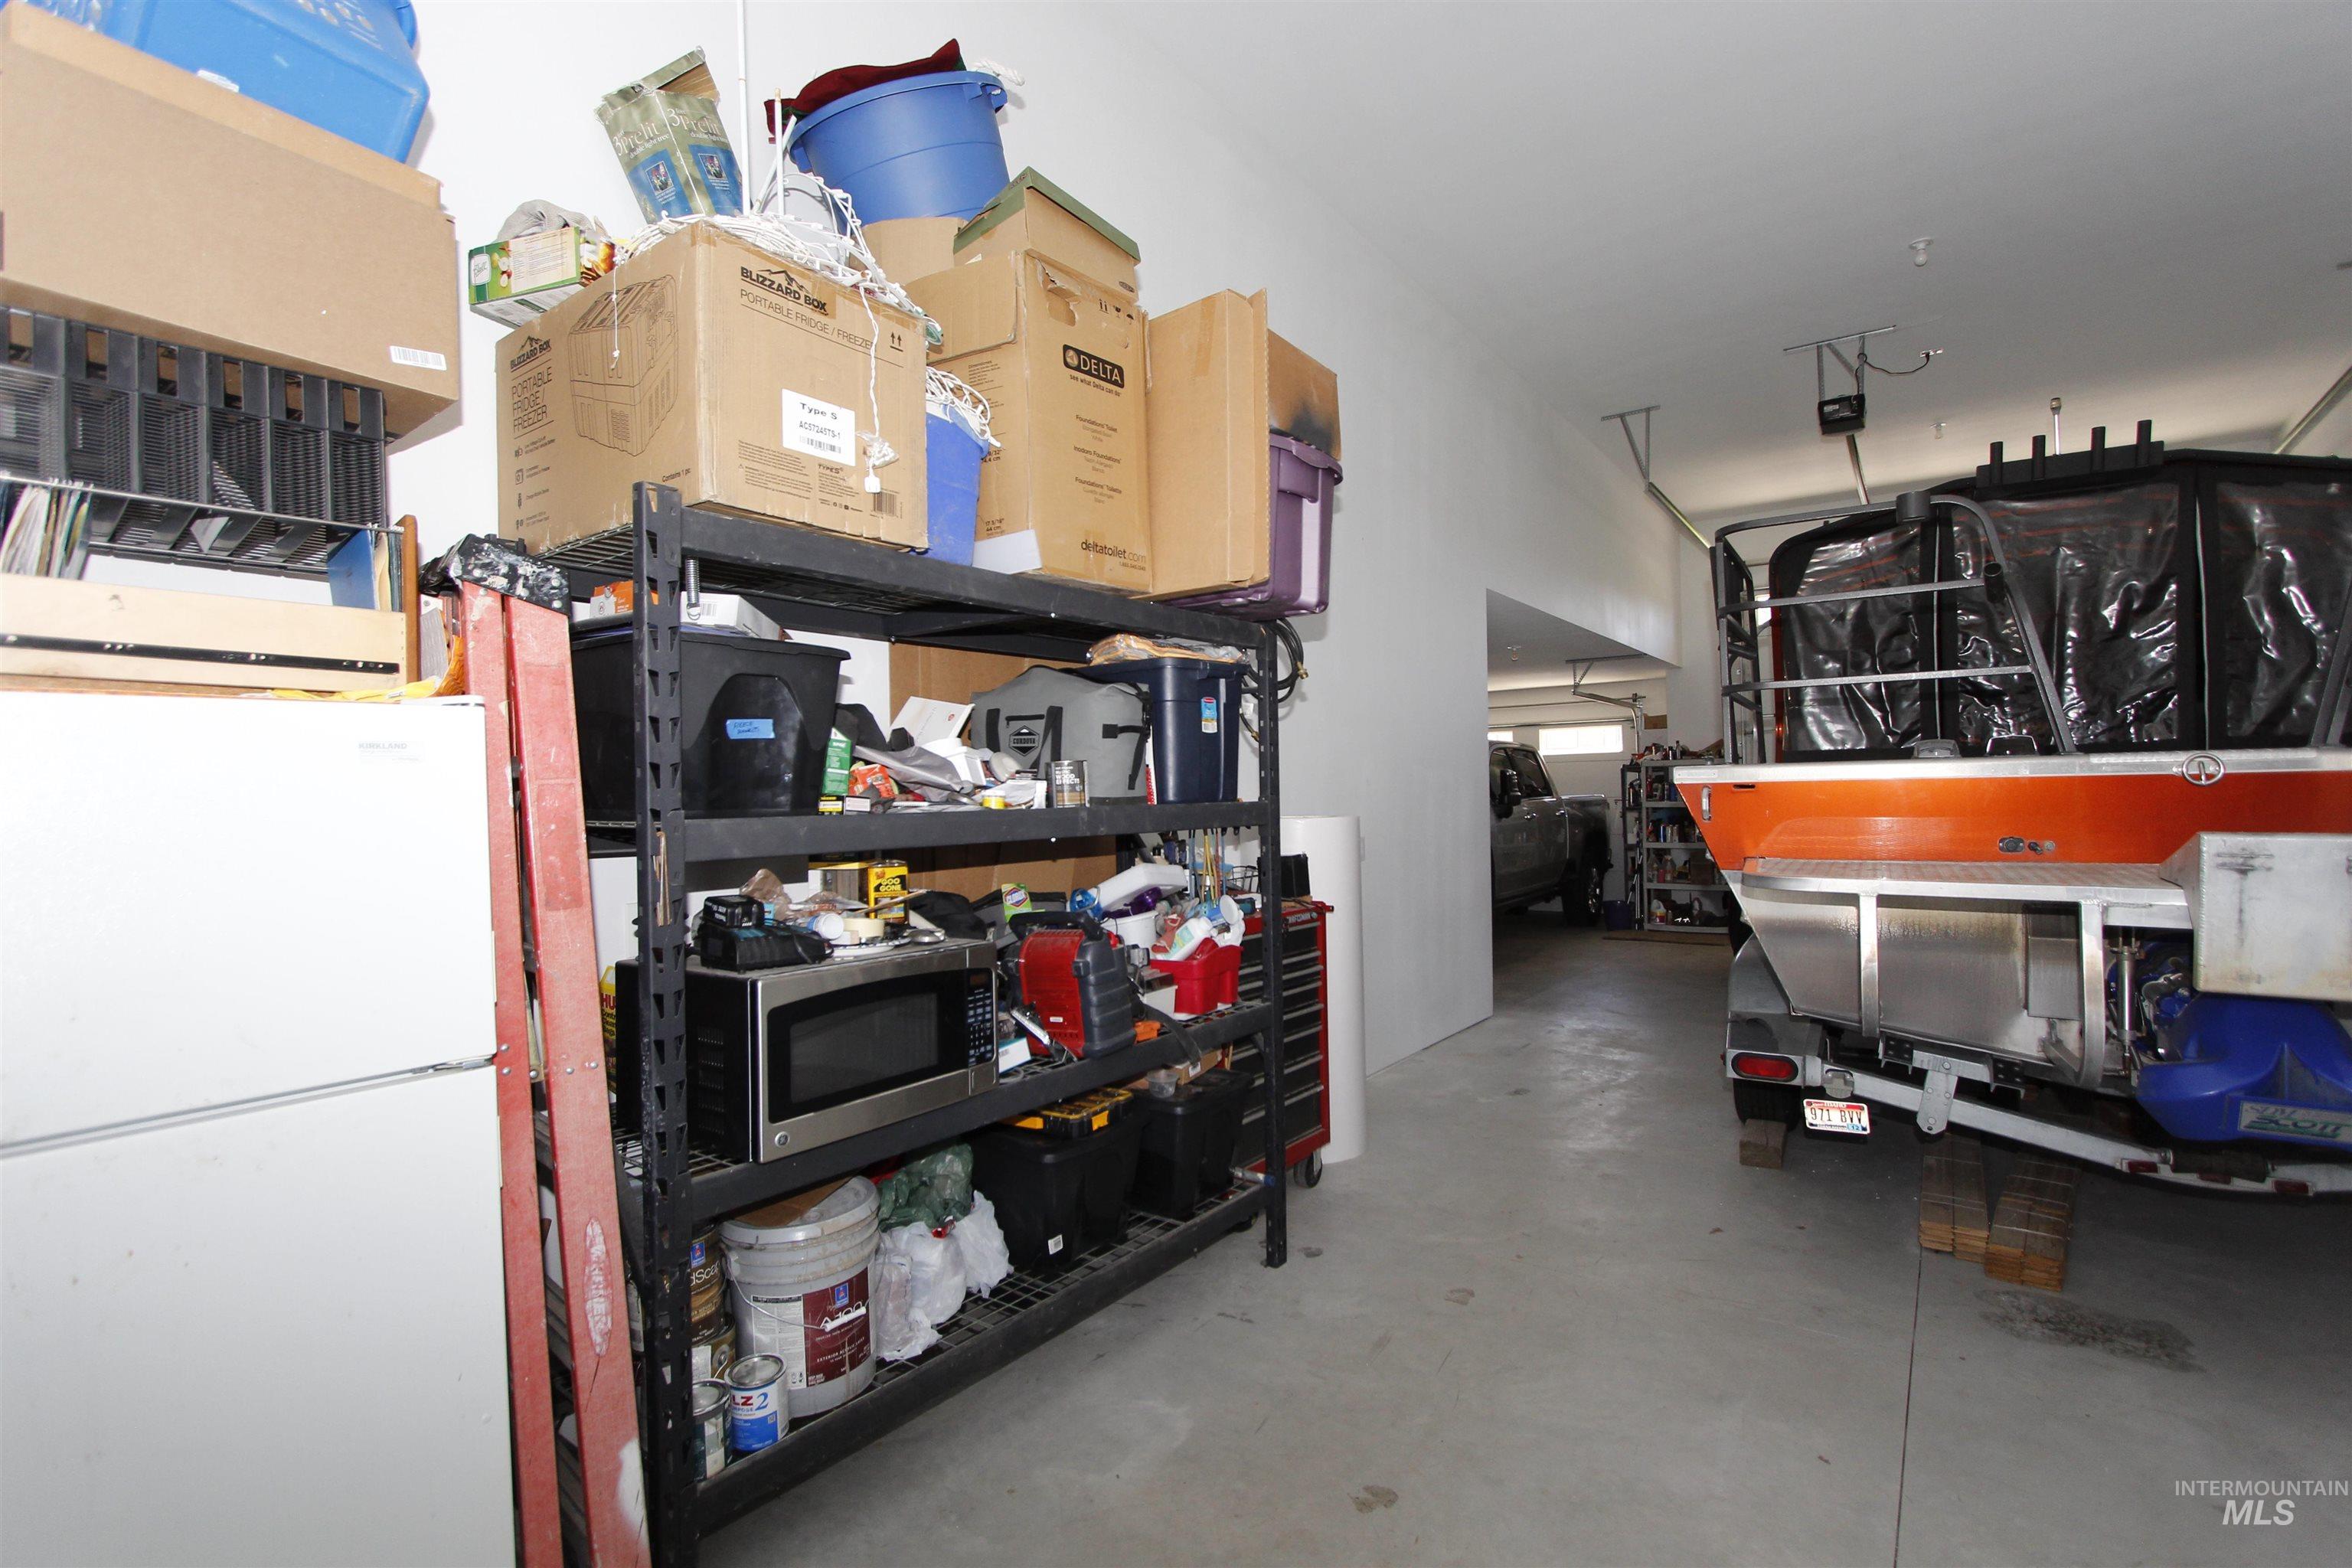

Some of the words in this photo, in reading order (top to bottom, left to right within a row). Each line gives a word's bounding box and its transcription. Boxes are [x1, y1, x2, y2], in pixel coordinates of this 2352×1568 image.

[740, 266, 801, 301] BLIZZARD
[804, 296, 827, 313] BOX
[740, 289, 793, 321] PORTABLE
[795, 311, 829, 335] FRIDGE
[510, 346, 538, 370] BLIZZARD
[538, 338, 552, 354] BOX
[1080, 354, 1121, 384] DELTA
[511, 366, 553, 398] PORTABLE
[513, 404, 547, 434] FREEZER
[800, 402, 827, 417] Type
[830, 412, 838, 420] S
[1080, 539, 1147, 564] deltatoilet.com
[1810, 1107, 1832, 1122] 971
[1840, 1109, 1862, 1124] BVV
[732, 1395, 753, 1406] LZ
[754, 1392, 769, 1411] 2
